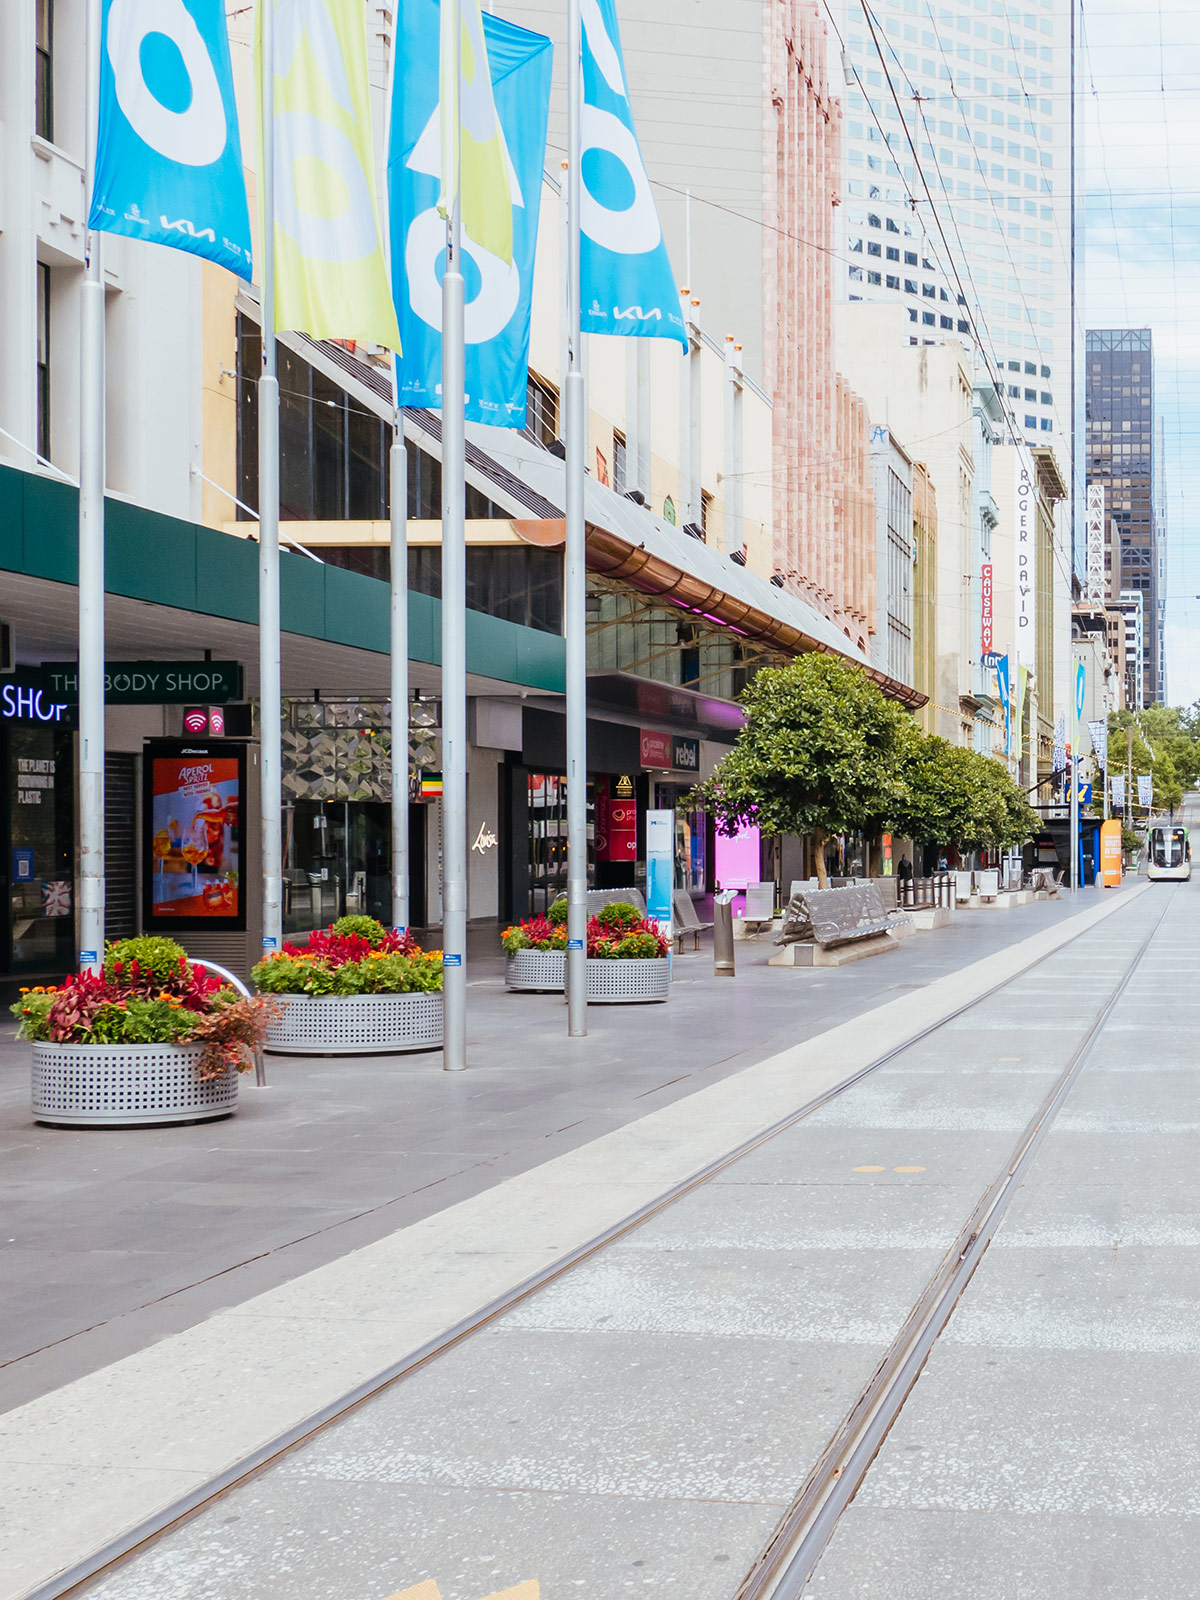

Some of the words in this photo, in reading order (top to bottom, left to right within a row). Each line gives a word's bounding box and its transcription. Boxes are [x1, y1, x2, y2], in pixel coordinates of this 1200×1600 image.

[1018, 469, 1030, 542] ROGER
[982, 566, 992, 647] CAUSEWAY
[1018, 554, 1029, 628] DAVID
[51, 674, 78, 691] TH
[166, 673, 224, 692] SHOP
[178, 764, 214, 780] APEROL
[675, 741, 696, 767] rebel
